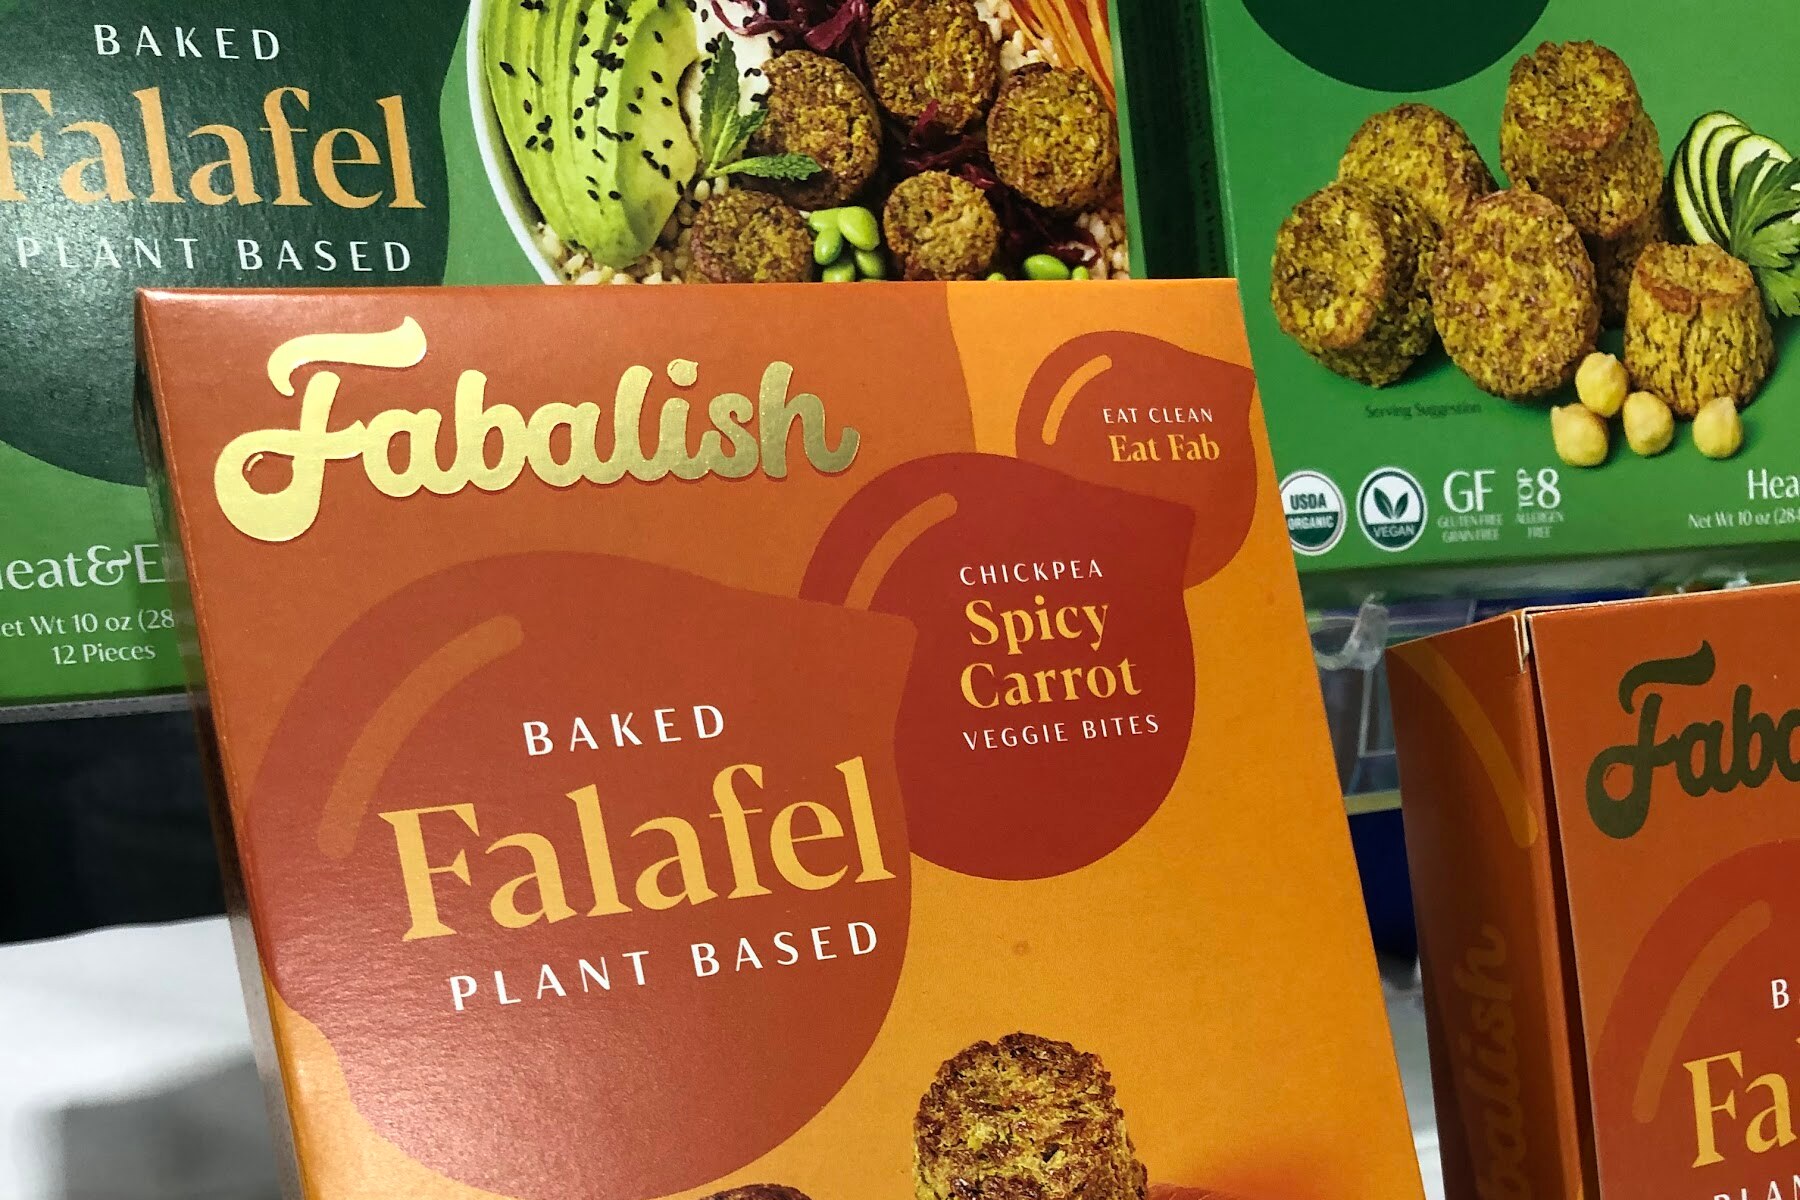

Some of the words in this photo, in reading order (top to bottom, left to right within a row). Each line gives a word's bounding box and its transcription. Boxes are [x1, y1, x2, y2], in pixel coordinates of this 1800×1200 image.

[94, 24, 281, 60] BAKED
[0, 86, 426, 210] Falafel
[16, 237, 199, 270] PLANT
[238, 239, 412, 272] BASED
[213, 316, 861, 542] Fabalish
[1103, 408, 1138, 424] EAT
[1149, 407, 1214, 424] CLEAN
[1108, 434, 1161, 463] Eat
[1167, 432, 1221, 462] Fab
[1289, 492, 1327, 510] USDA
[1443, 468, 1497, 514] GF
[1516, 467, 1535, 512] TOP
[1537, 467, 1561, 509] 8
[1287, 515, 1335, 531] ORGANIC
[1372, 524, 1415, 538] VEGAN
[0, 544, 166, 590] eat&E
[959, 559, 1103, 586] CHICKPEA
[30, 613, 66, 636] Wt
[72, 612, 98, 634] 10
[105, 615, 133, 632] oz
[965, 595, 1109, 656] Spicy
[52, 645, 77, 665] 12
[82, 642, 157, 664] Pieces
[960, 657, 1142, 709] Carrot
[522, 704, 725, 756] BAKED
[962, 722, 1068, 751] VEGGIE
[1082, 714, 1159, 740] BITES
[377, 755, 897, 942] Falafel
[449, 950, 650, 1011] PLANT
[690, 921, 879, 978] BASED
